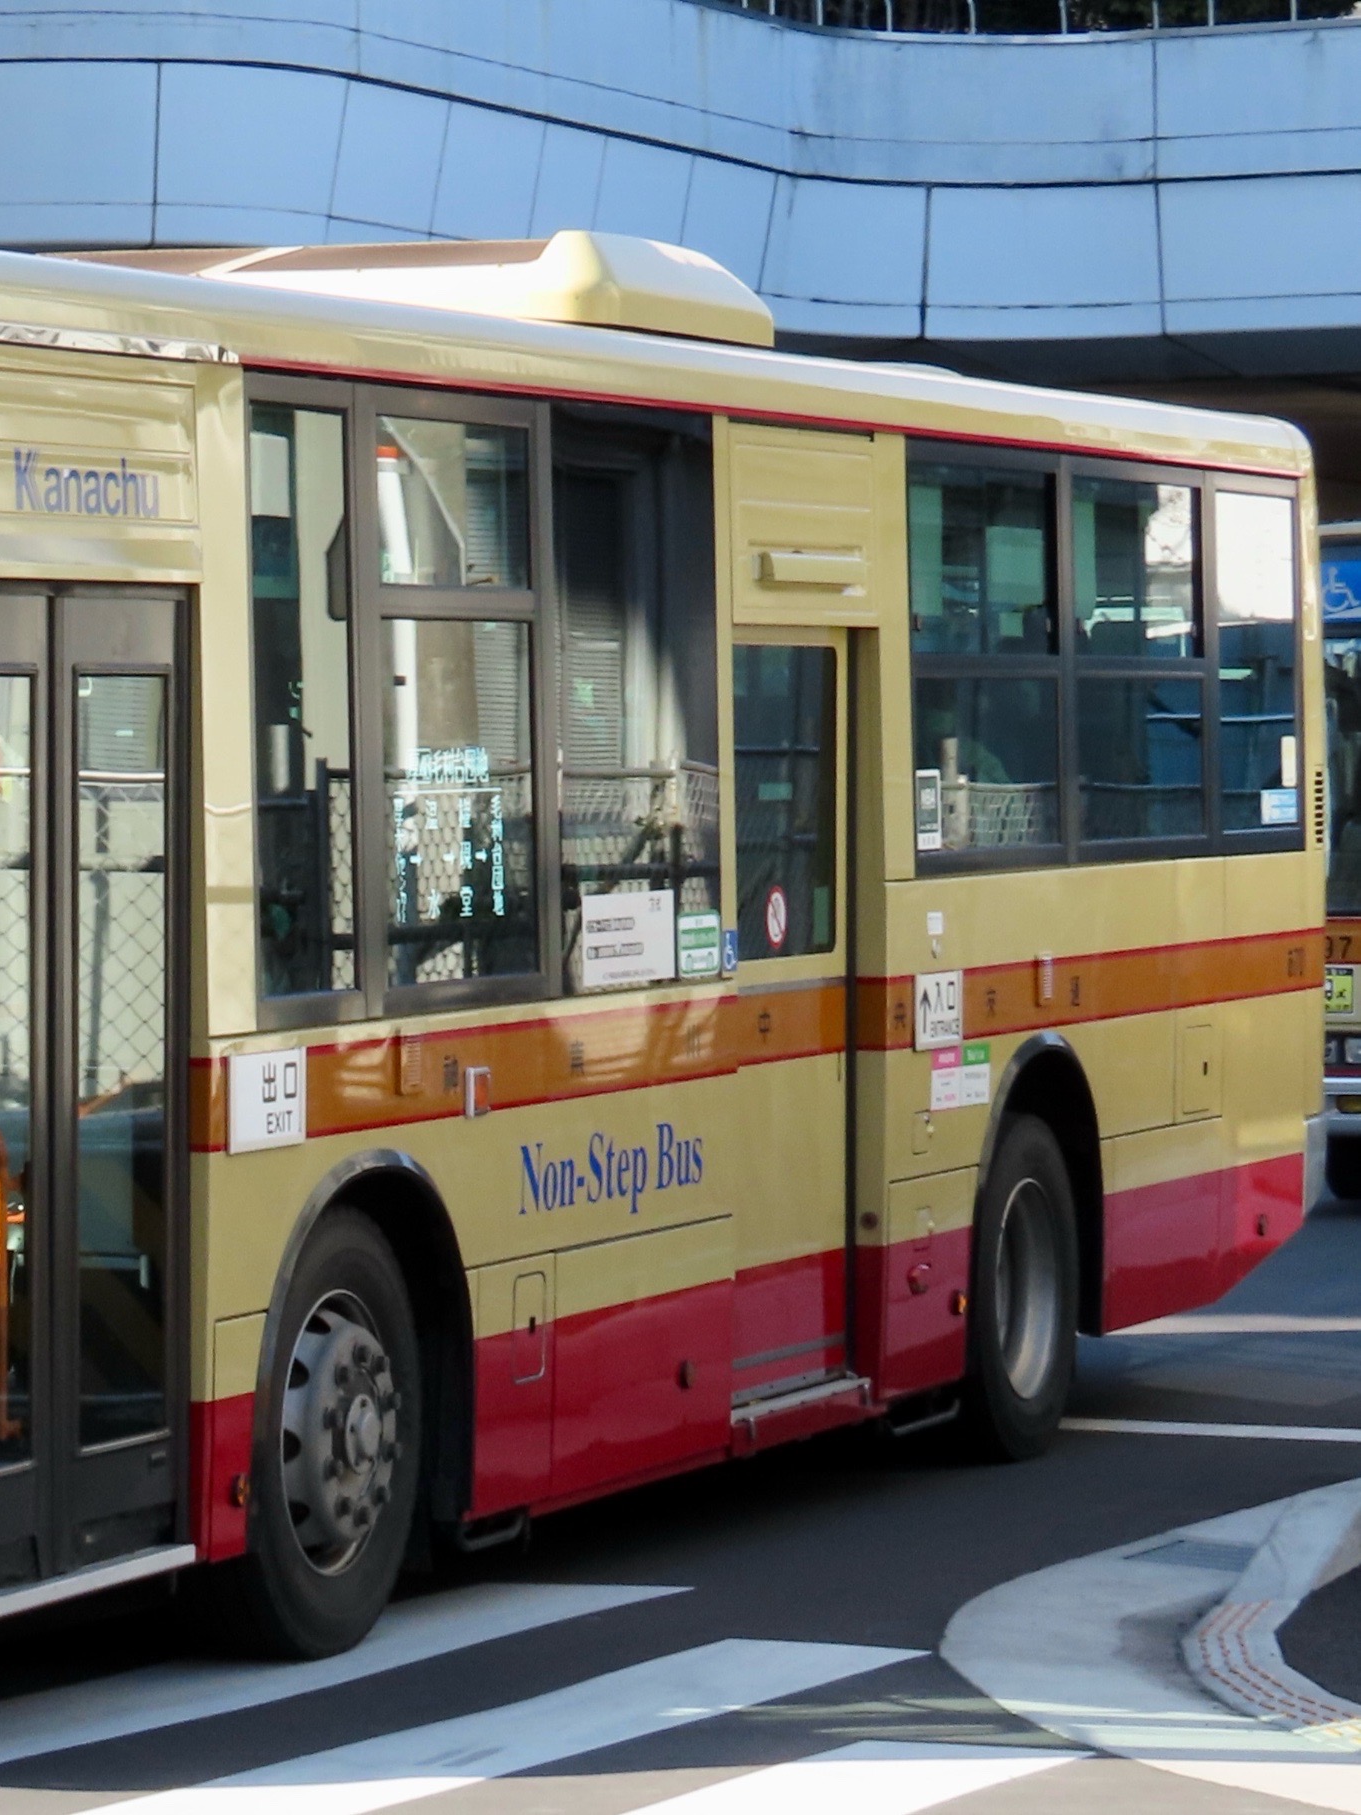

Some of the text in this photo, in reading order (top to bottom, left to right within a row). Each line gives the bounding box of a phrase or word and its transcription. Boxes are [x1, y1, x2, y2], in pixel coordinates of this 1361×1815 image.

[14, 448, 159, 518] Kanachu
[933, 980, 956, 1014] 入口
[262, 1061, 297, 1103] 出口
[266, 1110, 293, 1134] EXIT
[519, 1122, 703, 1215] Non-Step Bus
